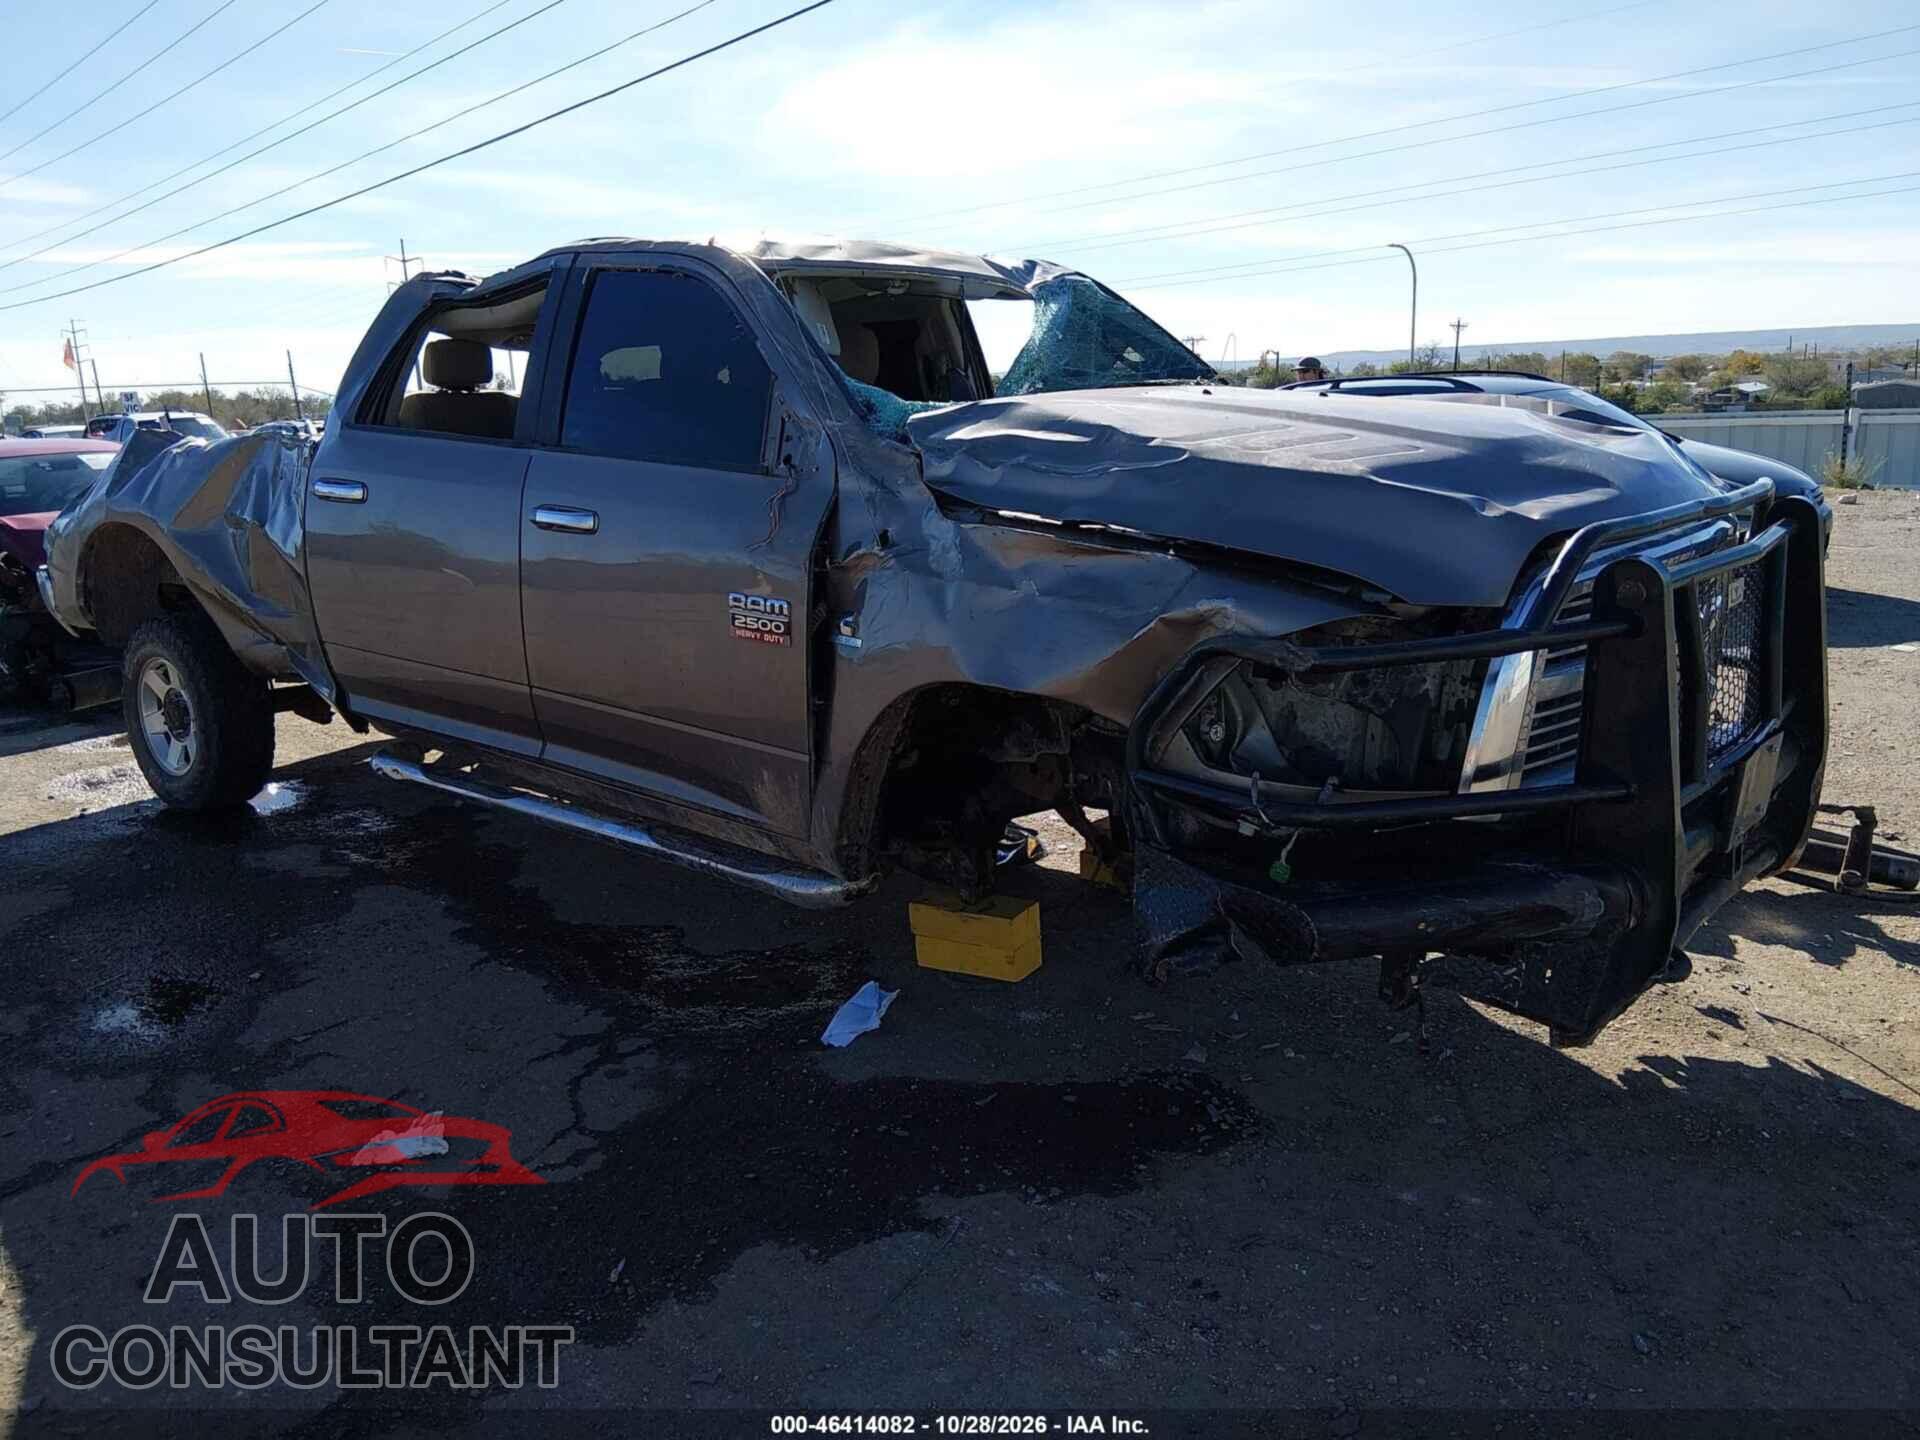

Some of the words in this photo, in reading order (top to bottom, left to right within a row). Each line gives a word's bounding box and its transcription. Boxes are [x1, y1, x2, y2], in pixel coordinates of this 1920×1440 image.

[734, 615, 785, 634] 2500
[735, 629, 761, 641] HEAVY
[763, 633, 785, 644] DUTY
